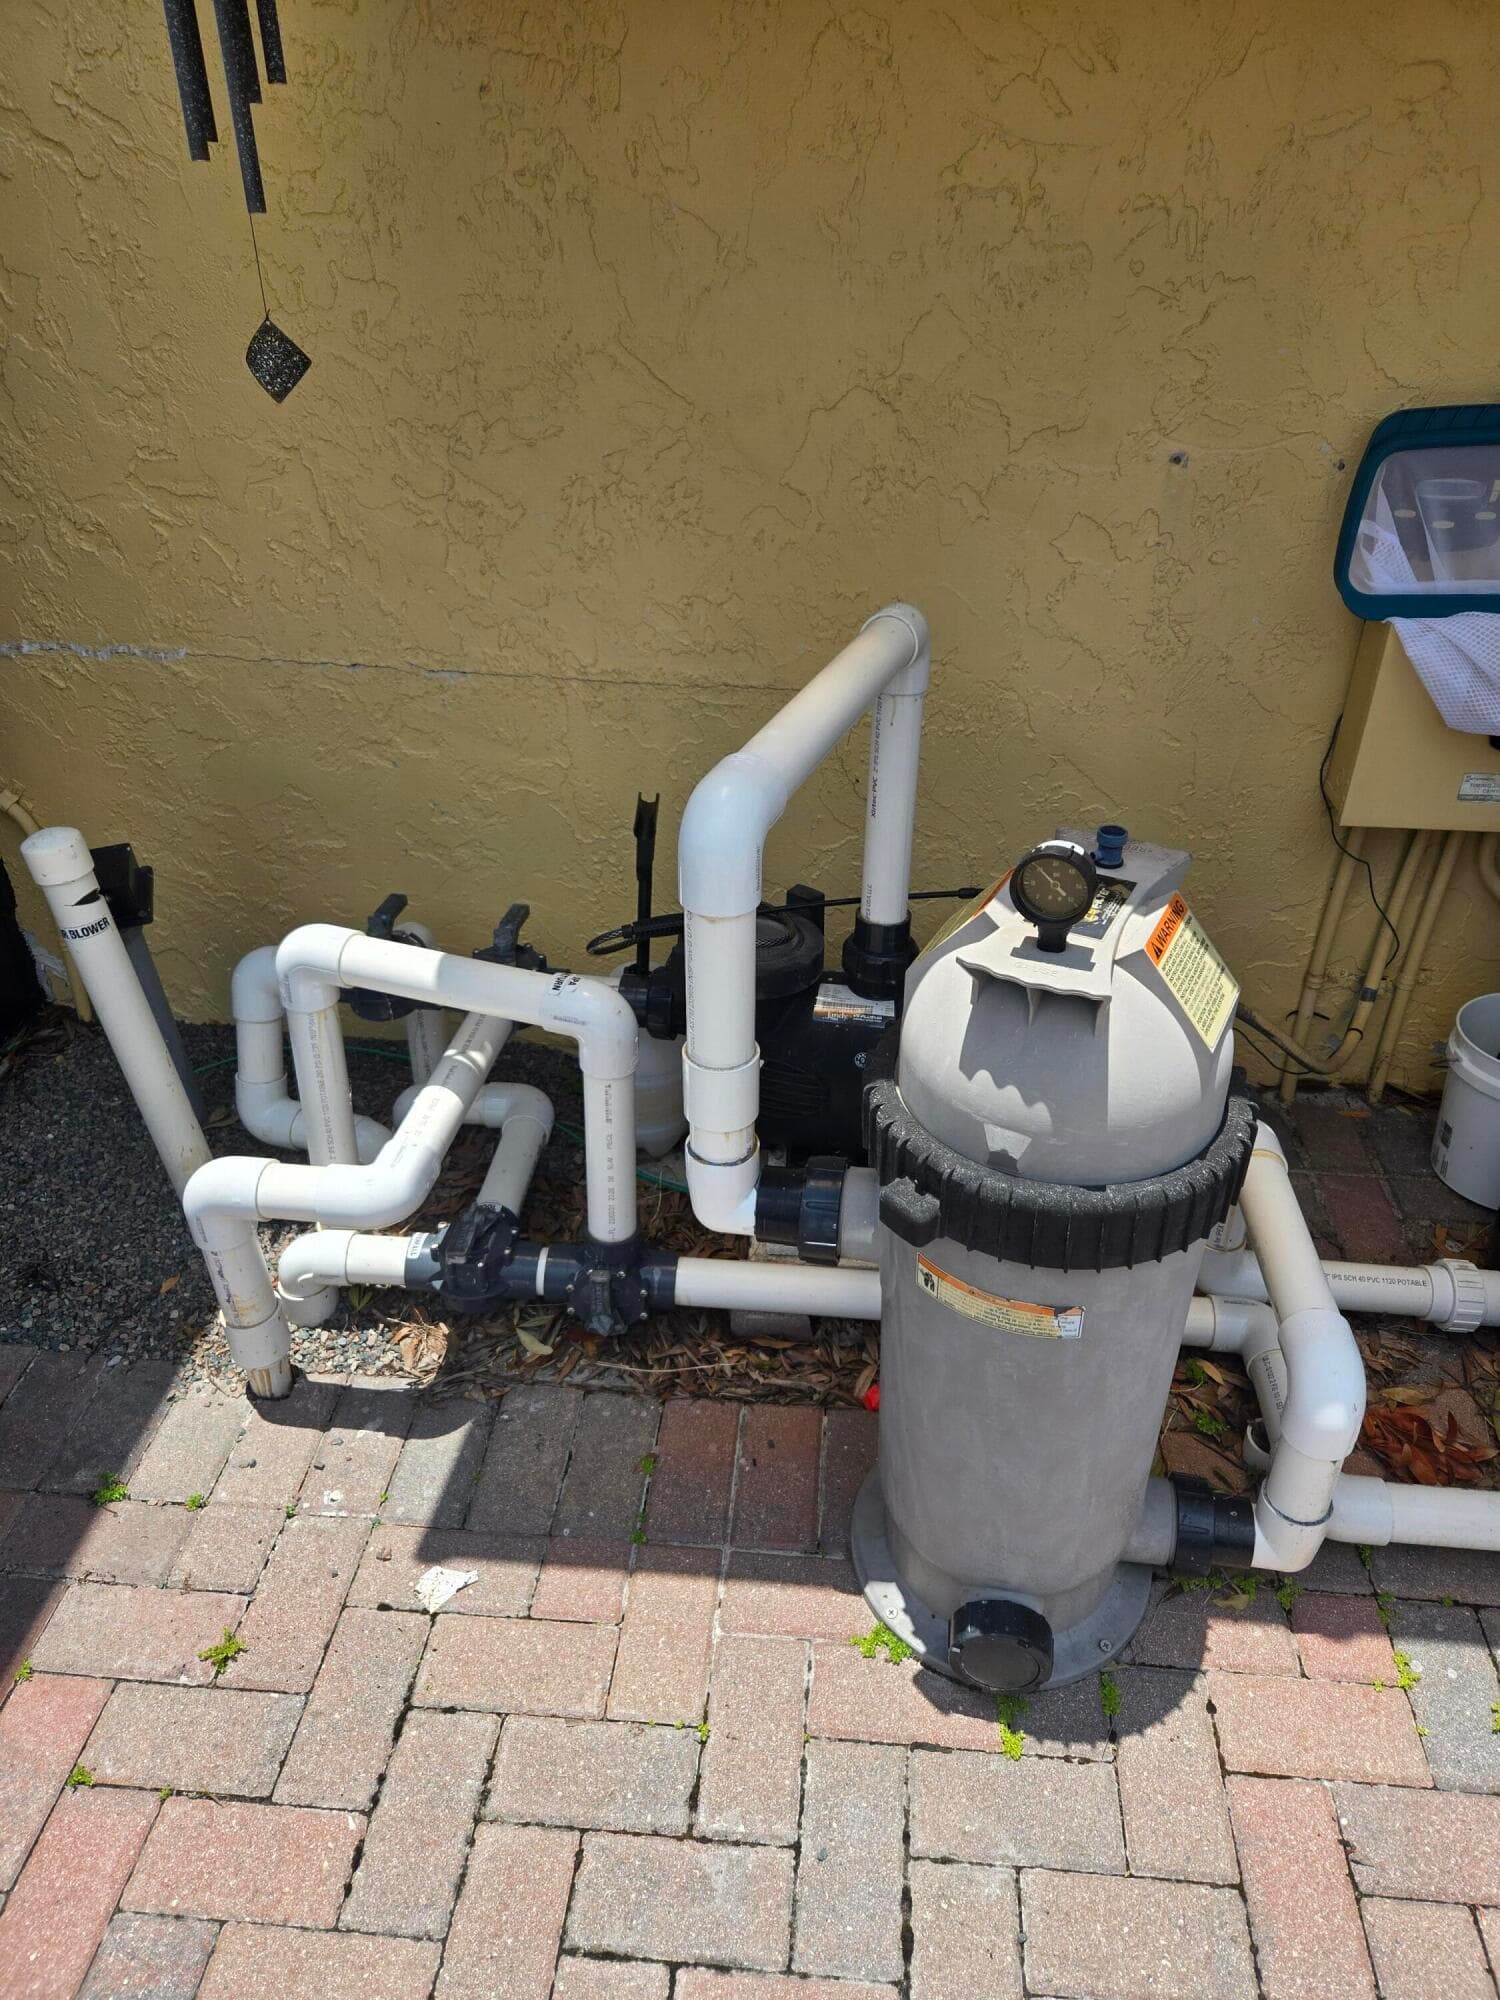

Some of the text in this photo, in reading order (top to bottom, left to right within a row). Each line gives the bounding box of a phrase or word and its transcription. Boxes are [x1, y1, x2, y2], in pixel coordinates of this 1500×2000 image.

[70, 917, 110, 939] BLOWER
[1156, 899, 1185, 948] WARNING
[1331, 1273, 1342, 1281] IPS
[1343, 1274, 1356, 1282] SCH
[1358, 1275, 1366, 1283] 40
[1367, 1276, 1380, 1284] PVC
[1382, 1277, 1396, 1285] 1120
[1397, 1278, 1428, 1287] POTABLE
